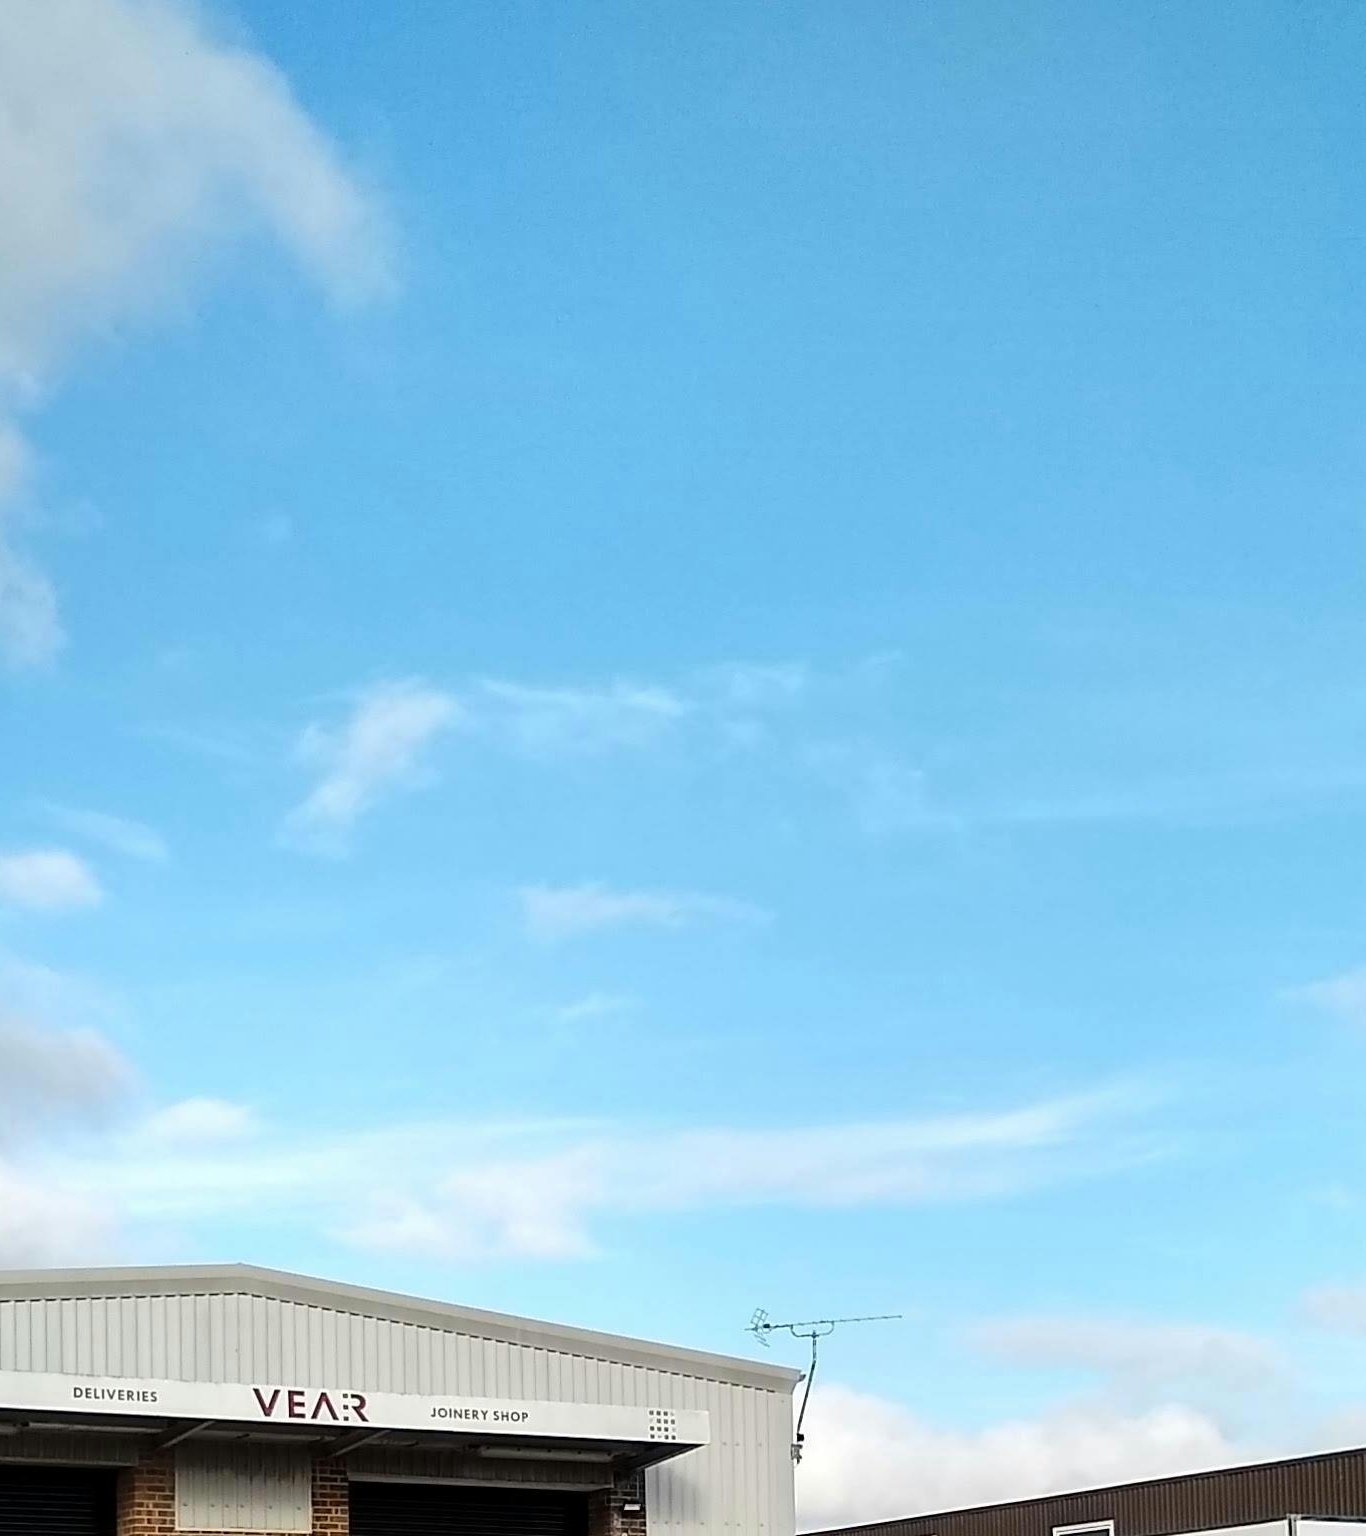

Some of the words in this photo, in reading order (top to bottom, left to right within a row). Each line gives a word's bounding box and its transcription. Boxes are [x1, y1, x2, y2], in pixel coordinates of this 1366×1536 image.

[72, 1386, 158, 1403] DELIVERIES
[252, 1387, 370, 1423] VEAR
[430, 1407, 489, 1421] JOINERY
[493, 1410, 529, 1423] SHOP
